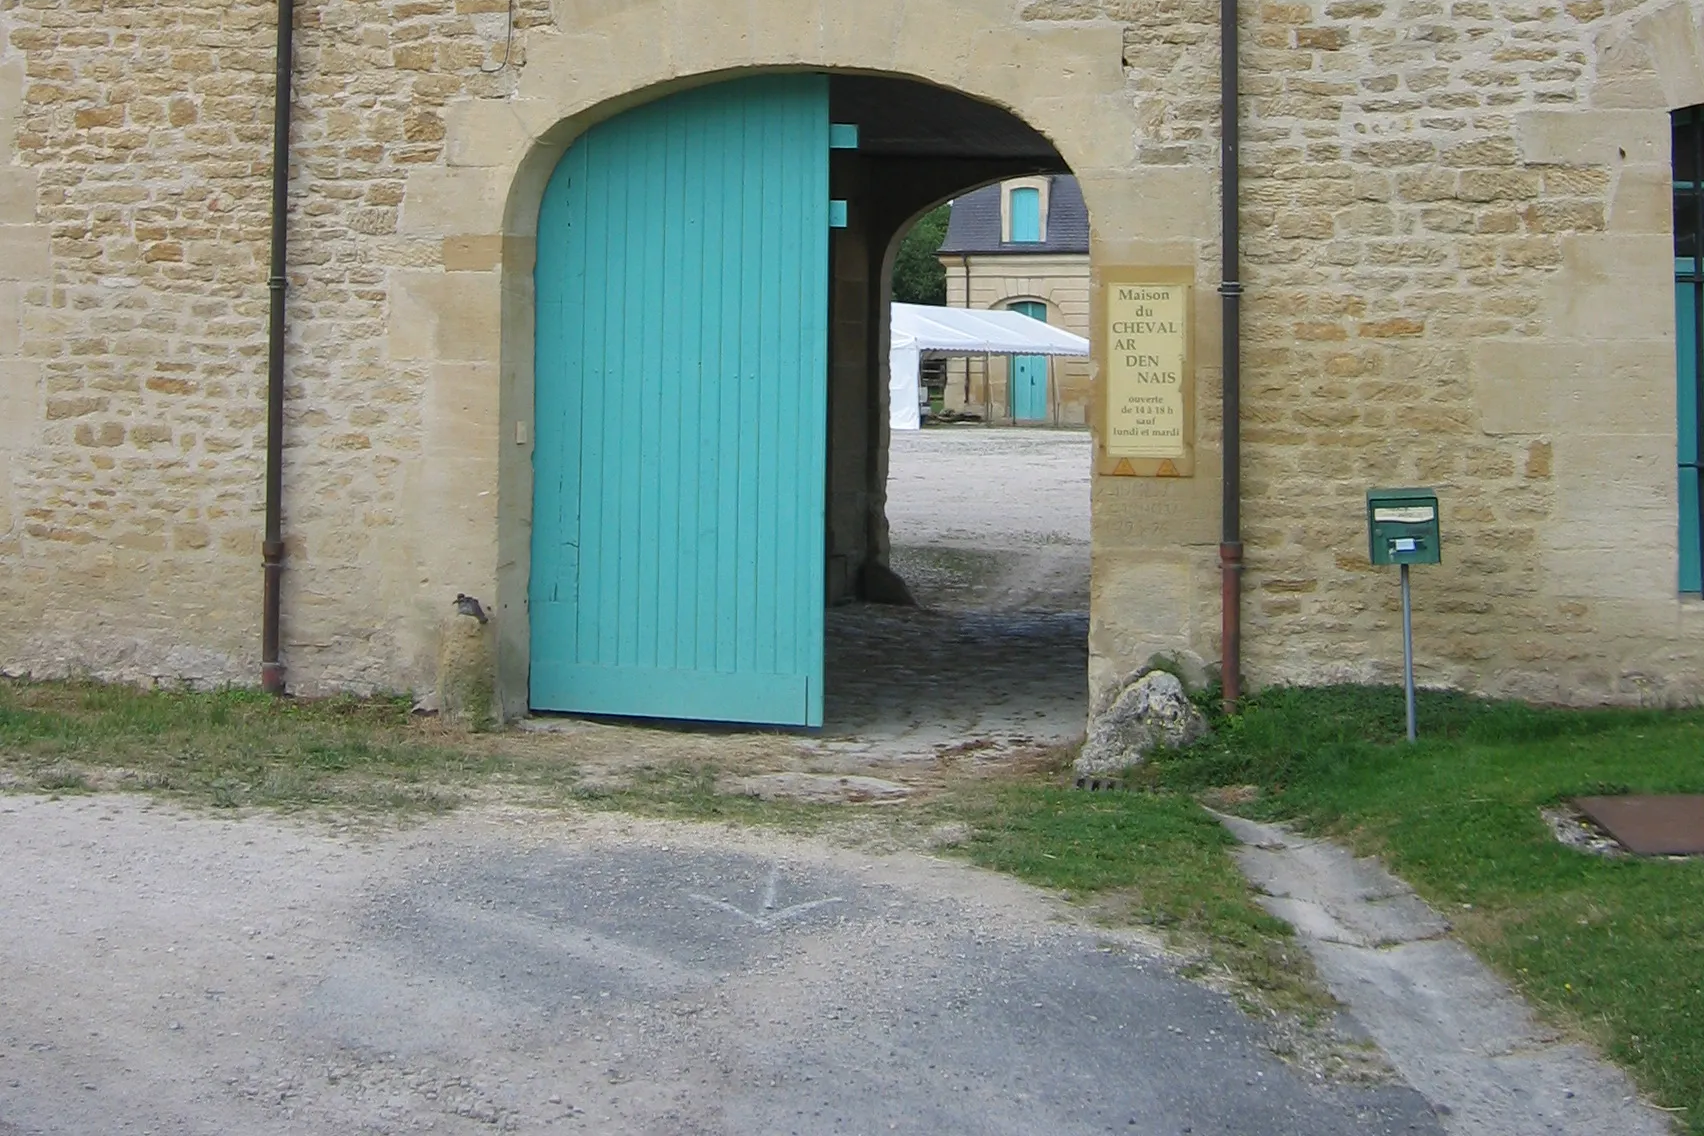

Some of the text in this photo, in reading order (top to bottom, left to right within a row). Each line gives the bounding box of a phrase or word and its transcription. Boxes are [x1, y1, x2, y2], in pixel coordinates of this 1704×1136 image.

[1119, 289, 1170, 301] Maison
[1135, 305, 1153, 317] du
[1112, 321, 1177, 334] CHEVAL
[1114, 338, 1137, 351] AR
[1126, 355, 1159, 367] DEN
[1137, 371, 1176, 384] NAIS
[1128, 396, 1163, 404] ouverte
[1121, 405, 1133, 414] de
[1135, 406, 1145, 414] 14
[1146, 405, 1153, 415] à
[1166, 406, 1174, 415] h
[1135, 416, 1156, 425] sauf
[1113, 427, 1180, 437] lundi et mardi
